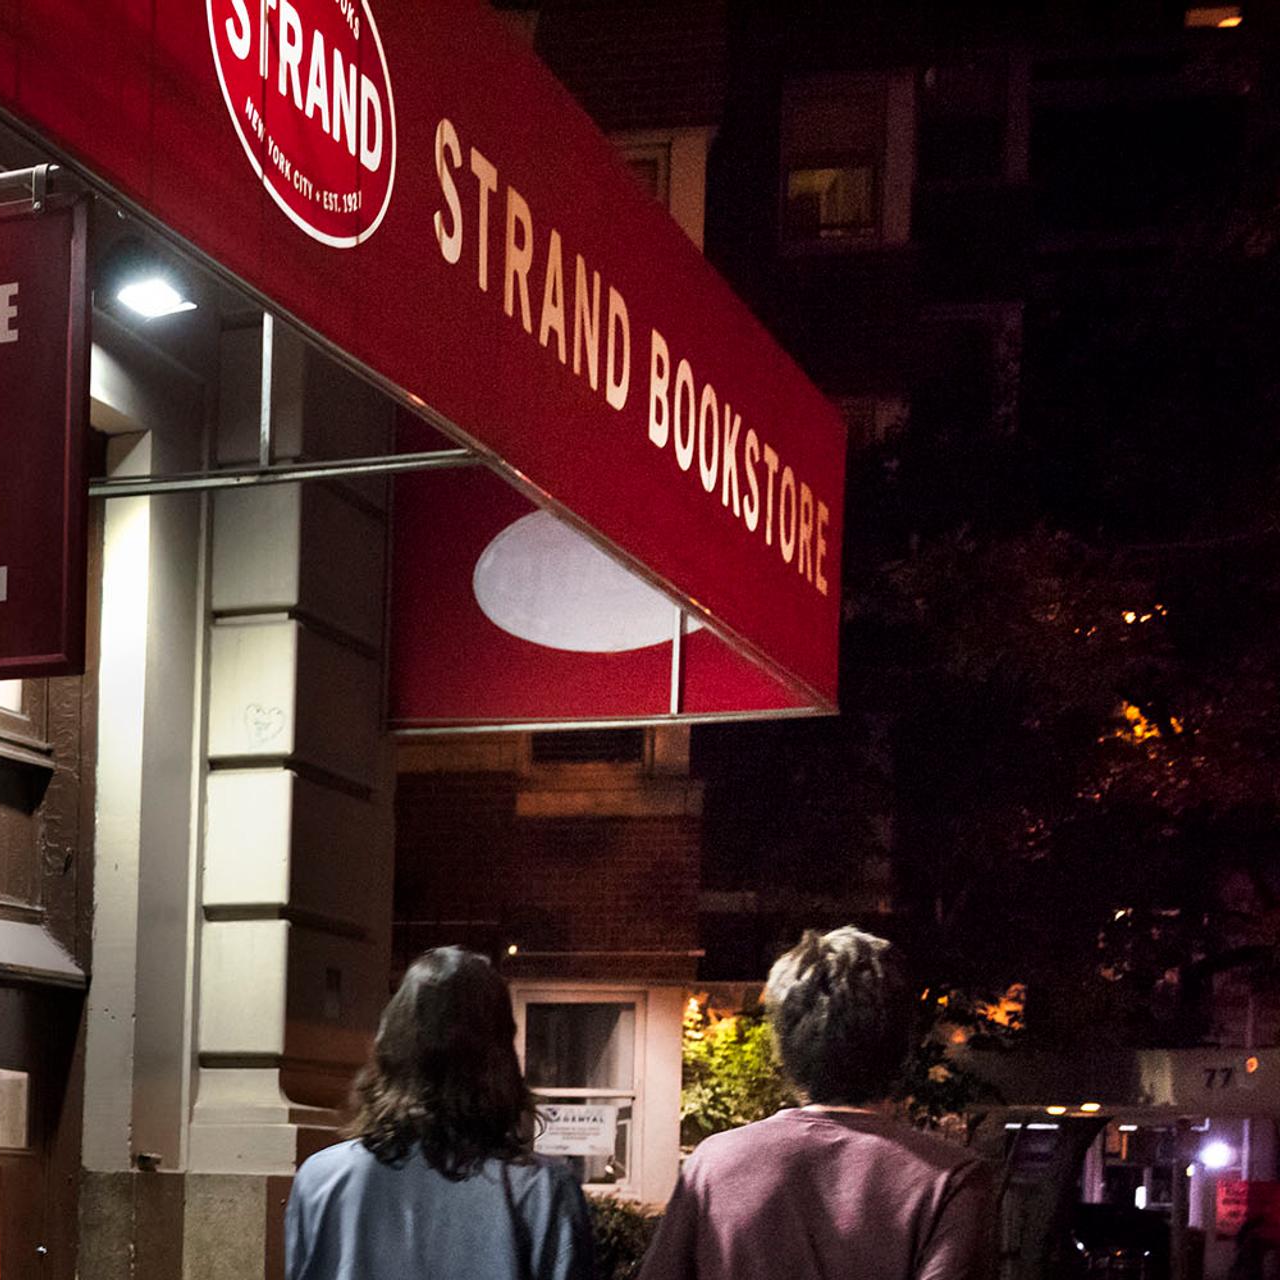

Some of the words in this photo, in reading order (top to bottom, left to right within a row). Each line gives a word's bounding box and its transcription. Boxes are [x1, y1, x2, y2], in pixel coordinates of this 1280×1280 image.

[335, 0, 360, 40] OKS
[225, 0, 383, 173] STRAND
[245, 96, 265, 142] NEW
[267, 135, 291, 181] YORK
[293, 170, 313, 200] CITY
[323, 190, 341, 213] EST.
[434, 118, 632, 411] STRAND
[648, 328, 830, 596] BOOKSTORE
[1203, 1067, 1233, 1090] 77
